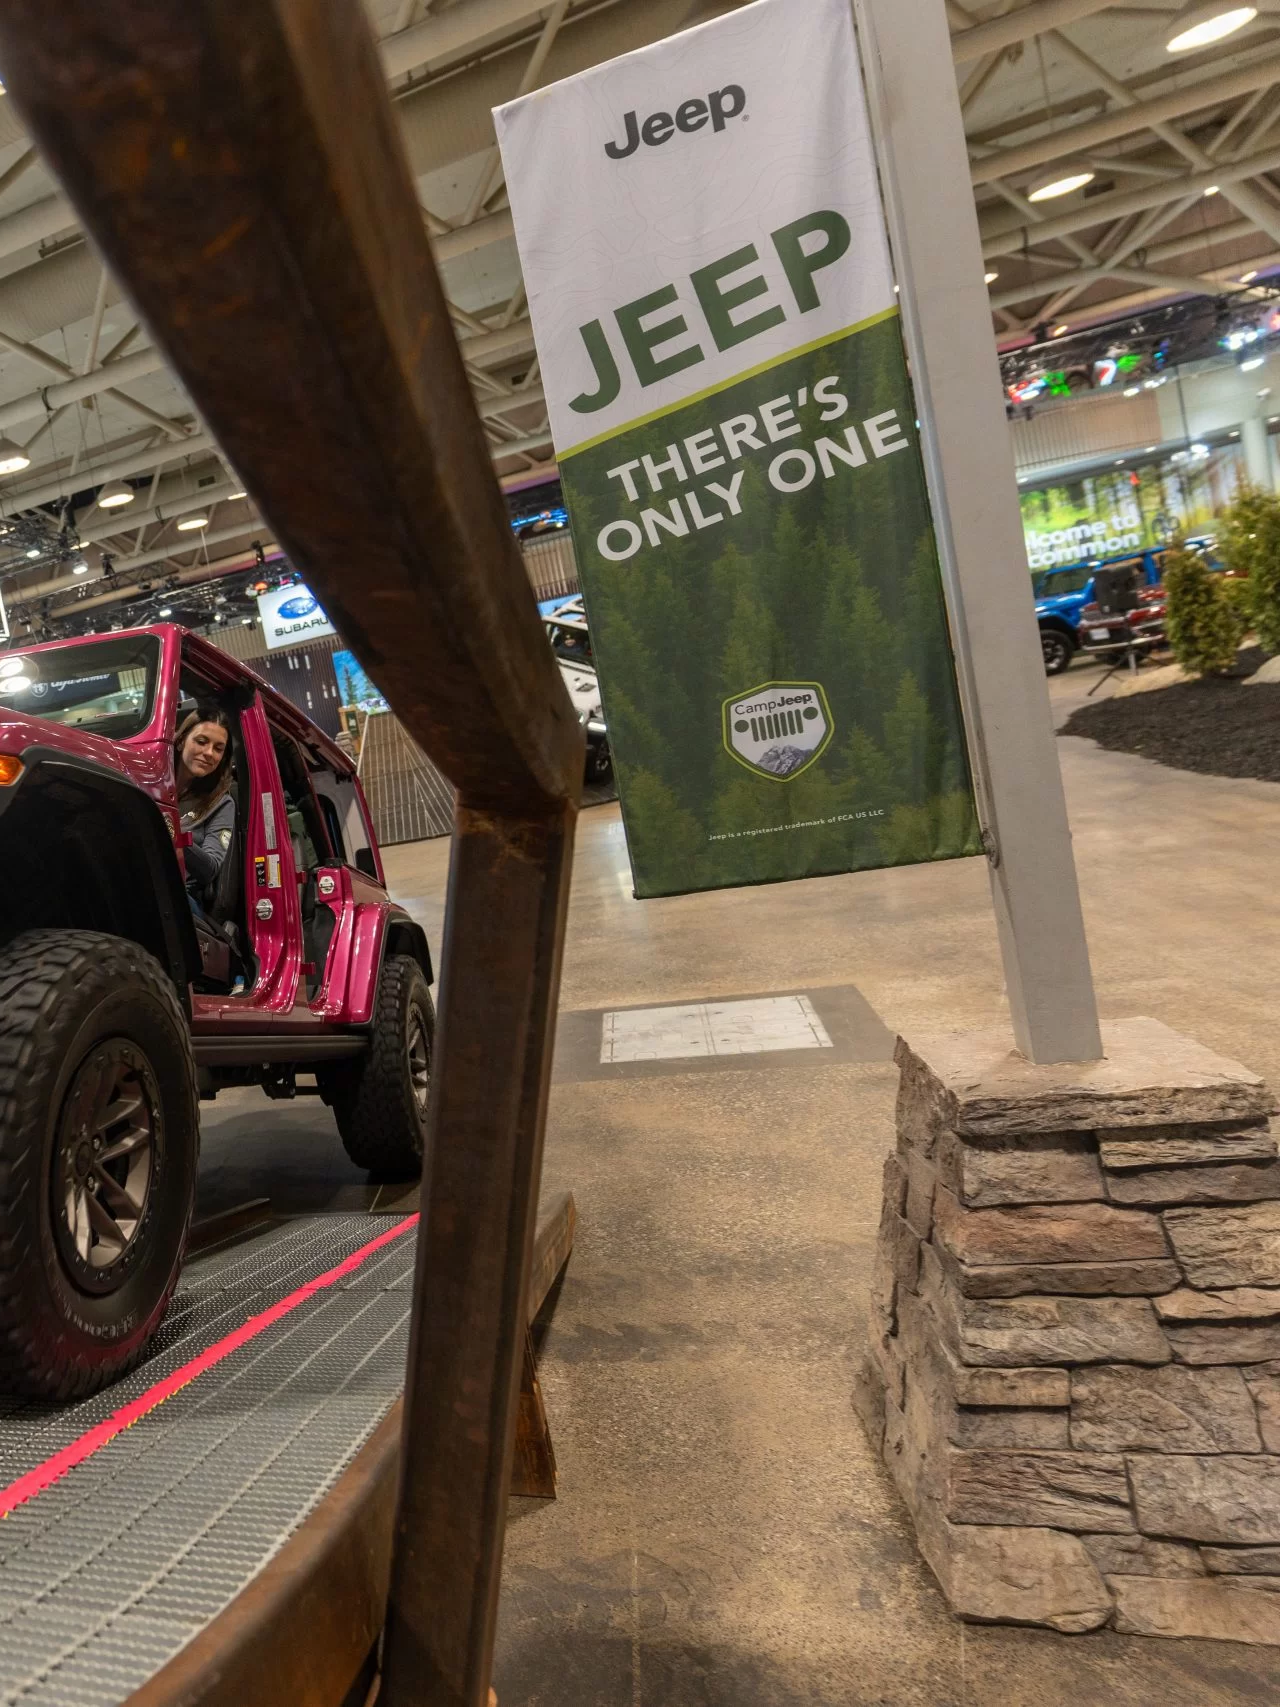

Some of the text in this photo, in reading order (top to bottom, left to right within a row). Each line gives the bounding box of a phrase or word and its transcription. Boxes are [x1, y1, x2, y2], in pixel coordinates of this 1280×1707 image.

[604, 84, 747, 160] Jeep
[567, 209, 852, 414] JEEP
[606, 375, 849, 502] THERE'S
[596, 408, 909, 561] ONLY ONE
[1025, 520, 1107, 549] lcome
[274, 616, 329, 636] SUBARU
[708, 833, 726, 841] Jeep
[743, 825, 783, 836] registered
[785, 818, 825, 829] trademark
[827, 816, 836, 824] of
[837, 814, 854, 822] FCA
[855, 811, 867, 819] US
[868, 809, 885, 817] LLC
